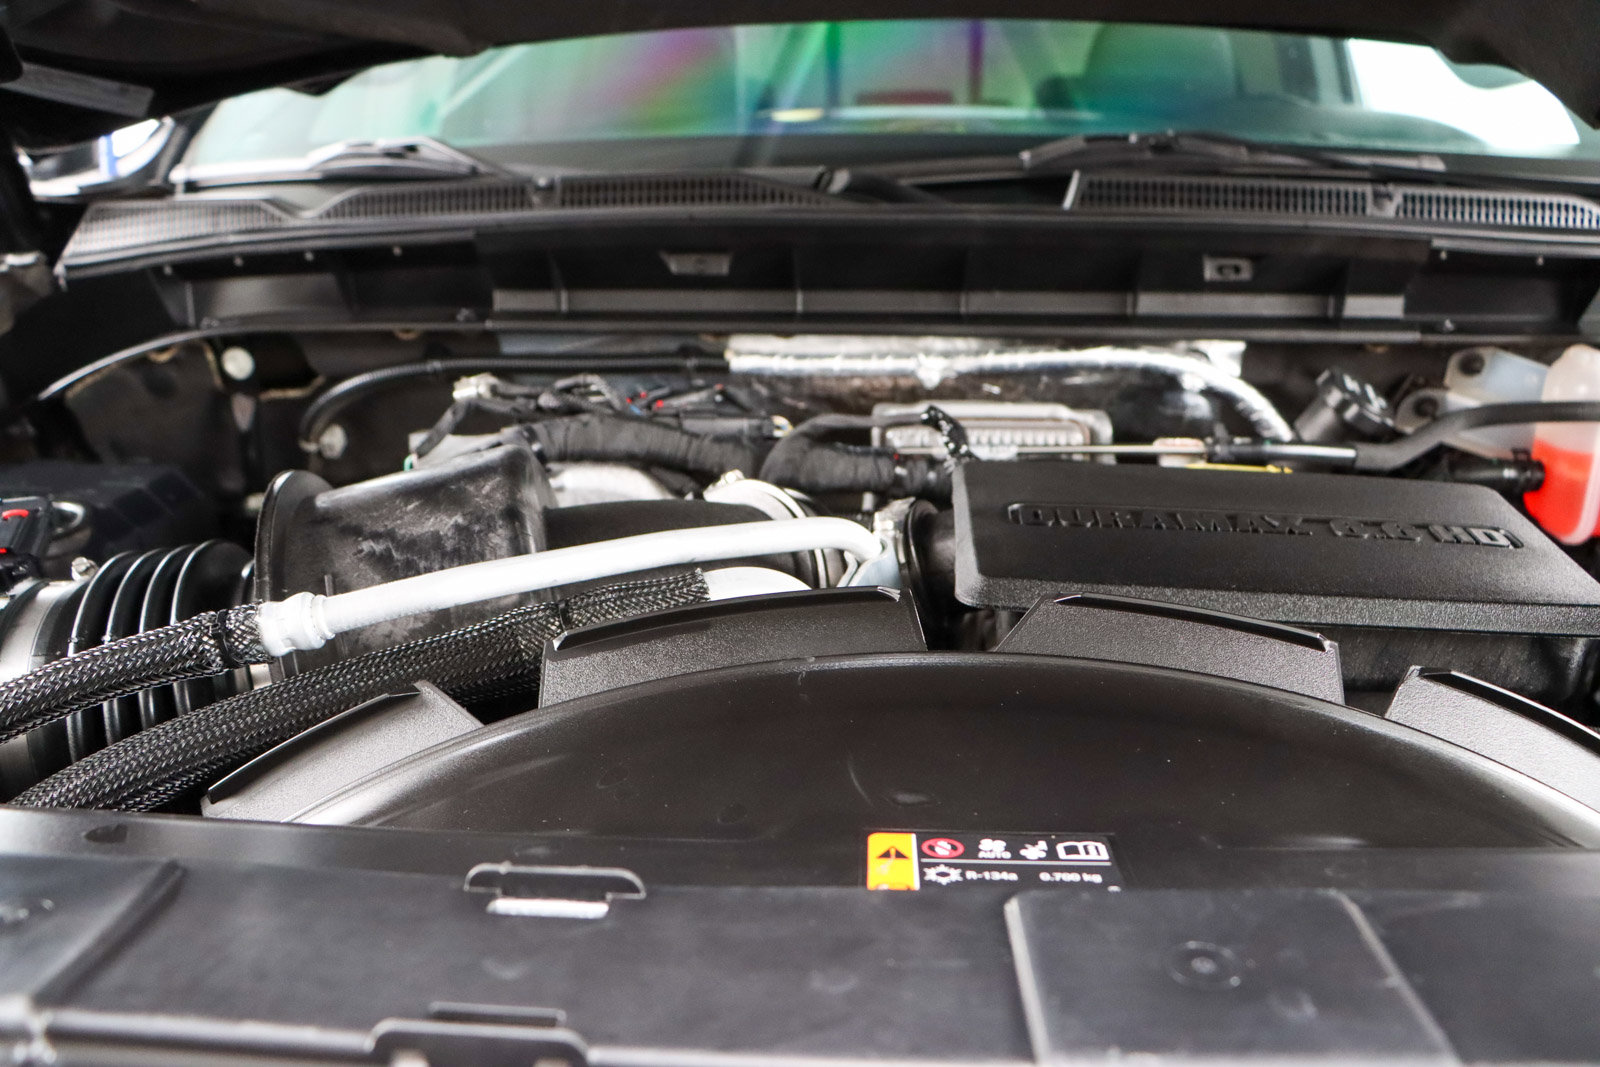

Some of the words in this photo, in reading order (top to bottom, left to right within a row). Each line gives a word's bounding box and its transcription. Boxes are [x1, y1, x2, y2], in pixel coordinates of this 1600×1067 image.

[1020, 505, 1313, 536] DURAMAX
[1427, 523, 1515, 549] HD
[978, 850, 1012, 859] AUTO
[1082, 872, 1103, 884] kg
